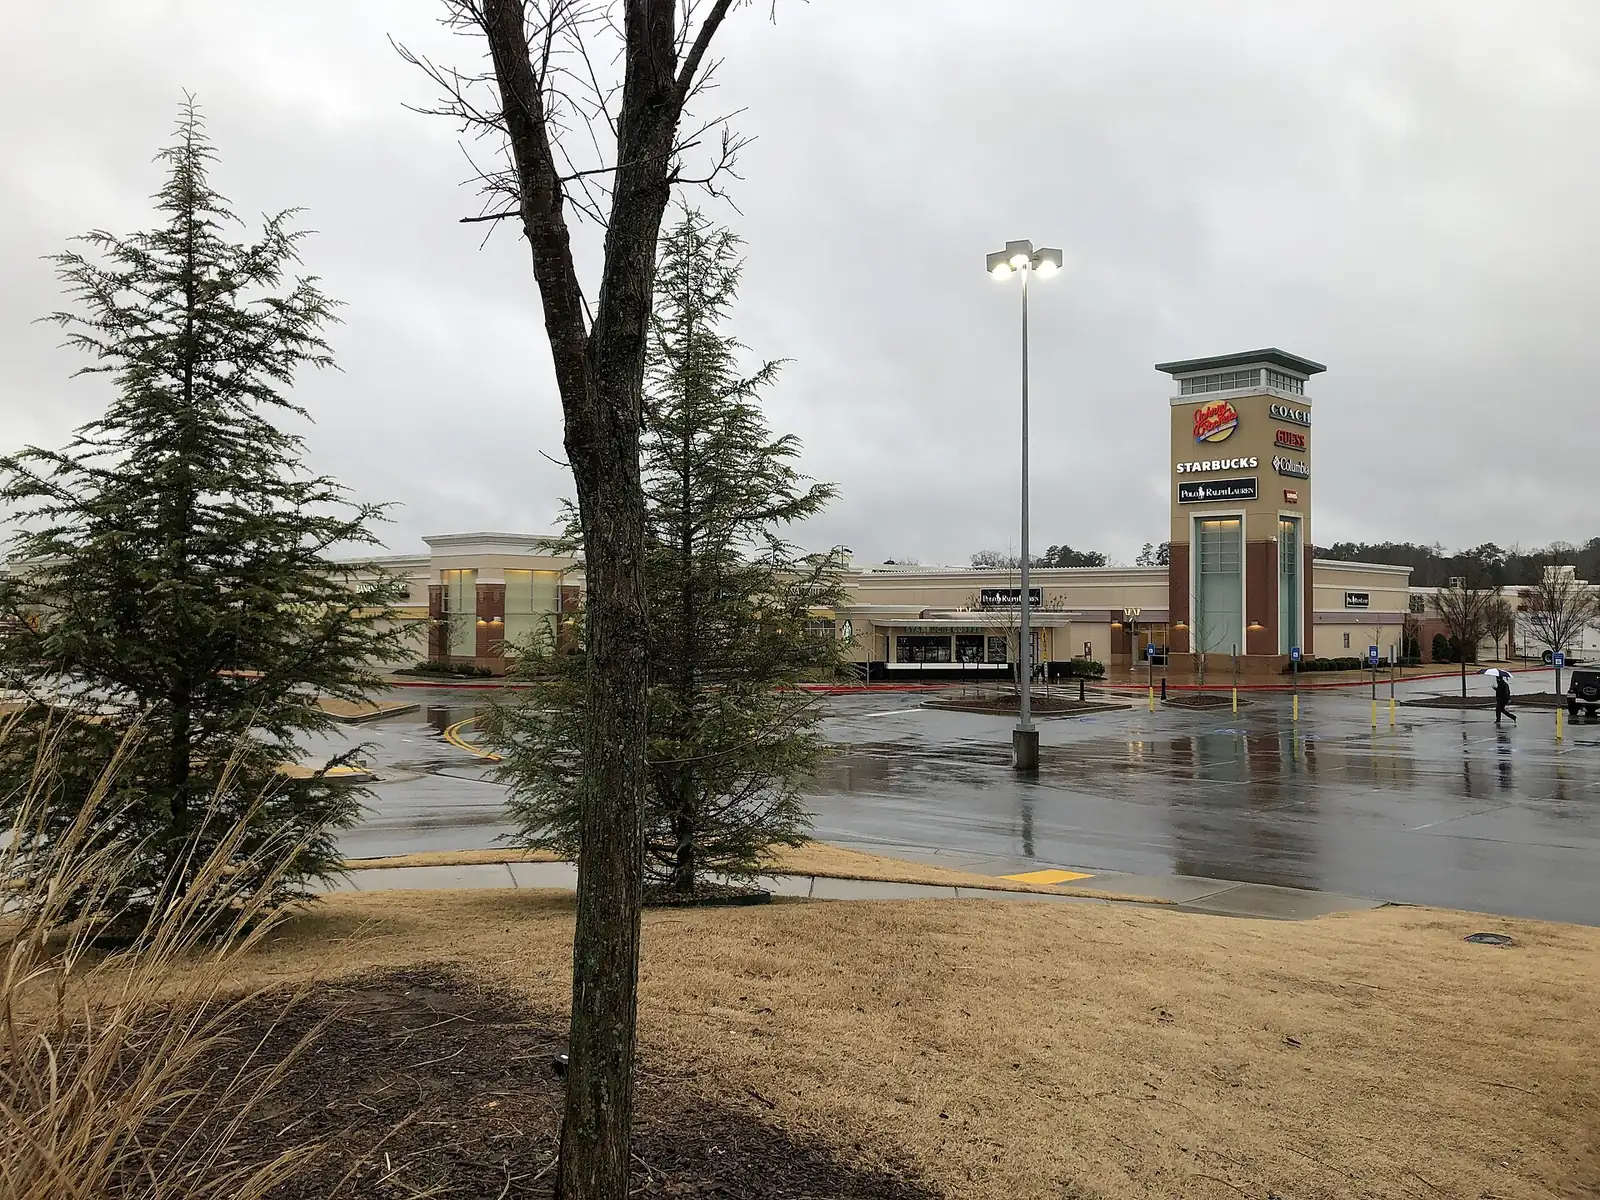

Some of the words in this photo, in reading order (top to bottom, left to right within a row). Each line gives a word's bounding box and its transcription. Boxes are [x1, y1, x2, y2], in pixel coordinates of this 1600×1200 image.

[1270, 403, 1310, 423] COACH
[1275, 429, 1305, 447] GUESS
[1176, 456, 1258, 473] STARBUCKS
[1279, 456, 1309, 474] Columbia
